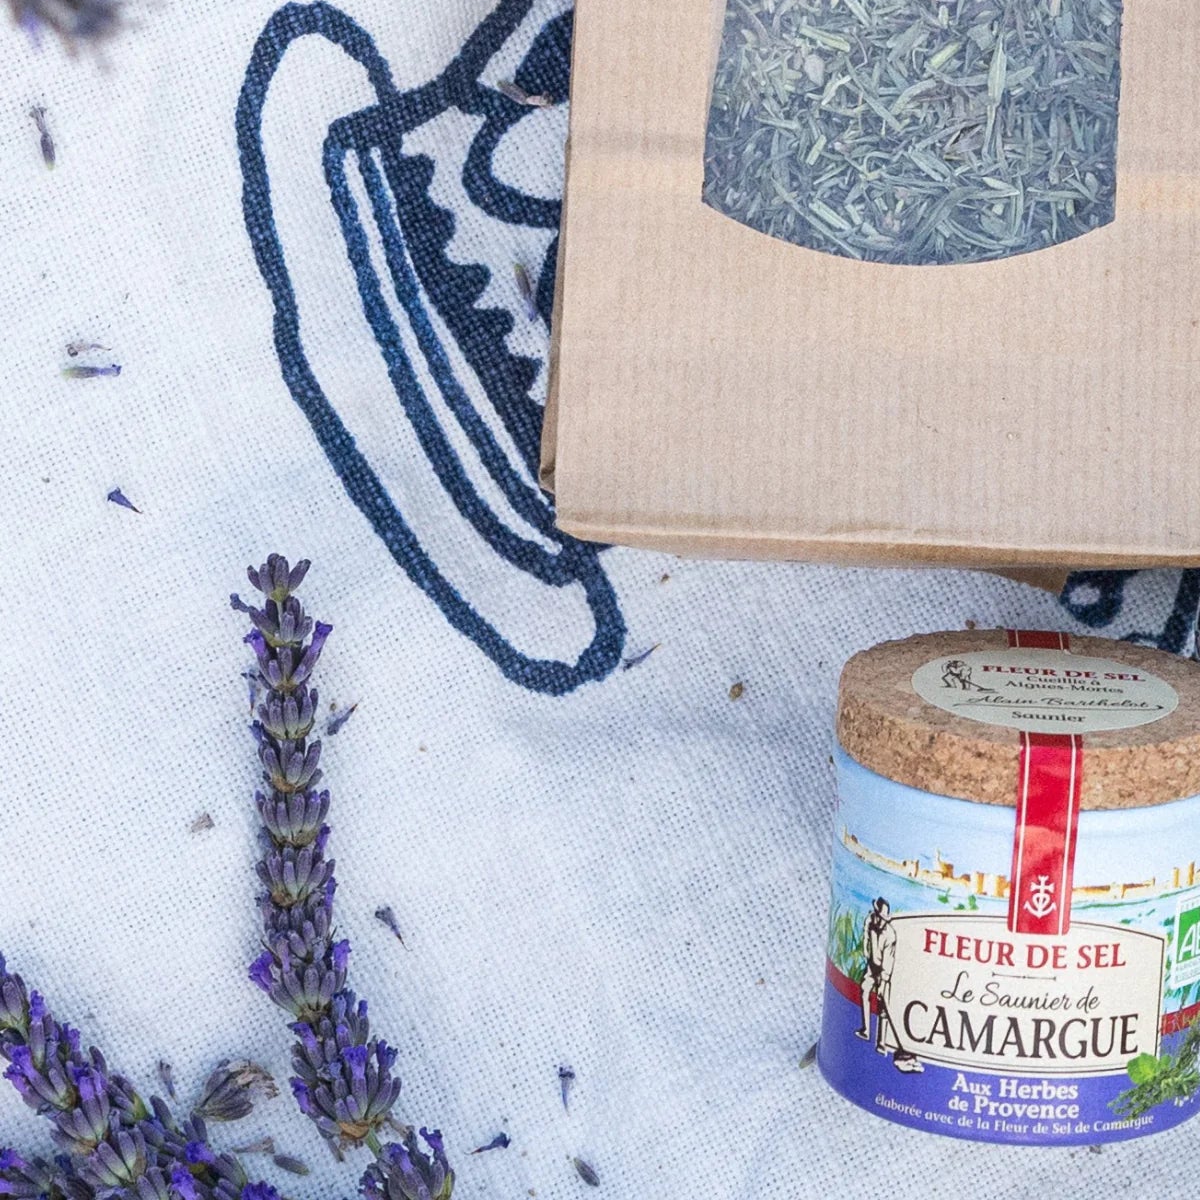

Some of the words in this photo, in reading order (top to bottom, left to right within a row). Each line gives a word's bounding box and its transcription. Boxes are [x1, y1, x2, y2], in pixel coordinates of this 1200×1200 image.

[981, 665, 1057, 677] FLEUR
[1065, 669, 1098, 680] DE
[1104, 672, 1146, 682] SEL
[1026, 675, 1087, 685] Cueillie
[1005, 680, 1124, 694] Aigues-Mortes
[967, 695, 1039, 705] Alain
[1011, 711, 1087, 723] Saunier
[923, 928, 1013, 967] FLEUR
[1027, 944, 1067, 969] DE
[1076, 943, 1127, 969] SEL
[940, 970, 975, 1003] Le
[979, 982, 1074, 1010] Saunier
[1076, 988, 1100, 1009] de
[902, 999, 1140, 1059] CAMARGUE
[951, 1073, 992, 1096] Aux
[999, 1080, 1079, 1101] Herbes
[875, 1092, 922, 1118] élaborée
[924, 1111, 954, 1125] avec
[957, 1115, 974, 1128] de
[977, 1118, 990, 1130] la
[994, 1120, 1028, 1134] Fleur
[1032, 1122, 1049, 1134] de
[1052, 1121, 1072, 1135] Sel
[1075, 1120, 1090, 1133] de
[1093, 1113, 1155, 1133] Camargue
[948, 1096, 968, 1112] de
[974, 1099, 1080, 1119] Provence
